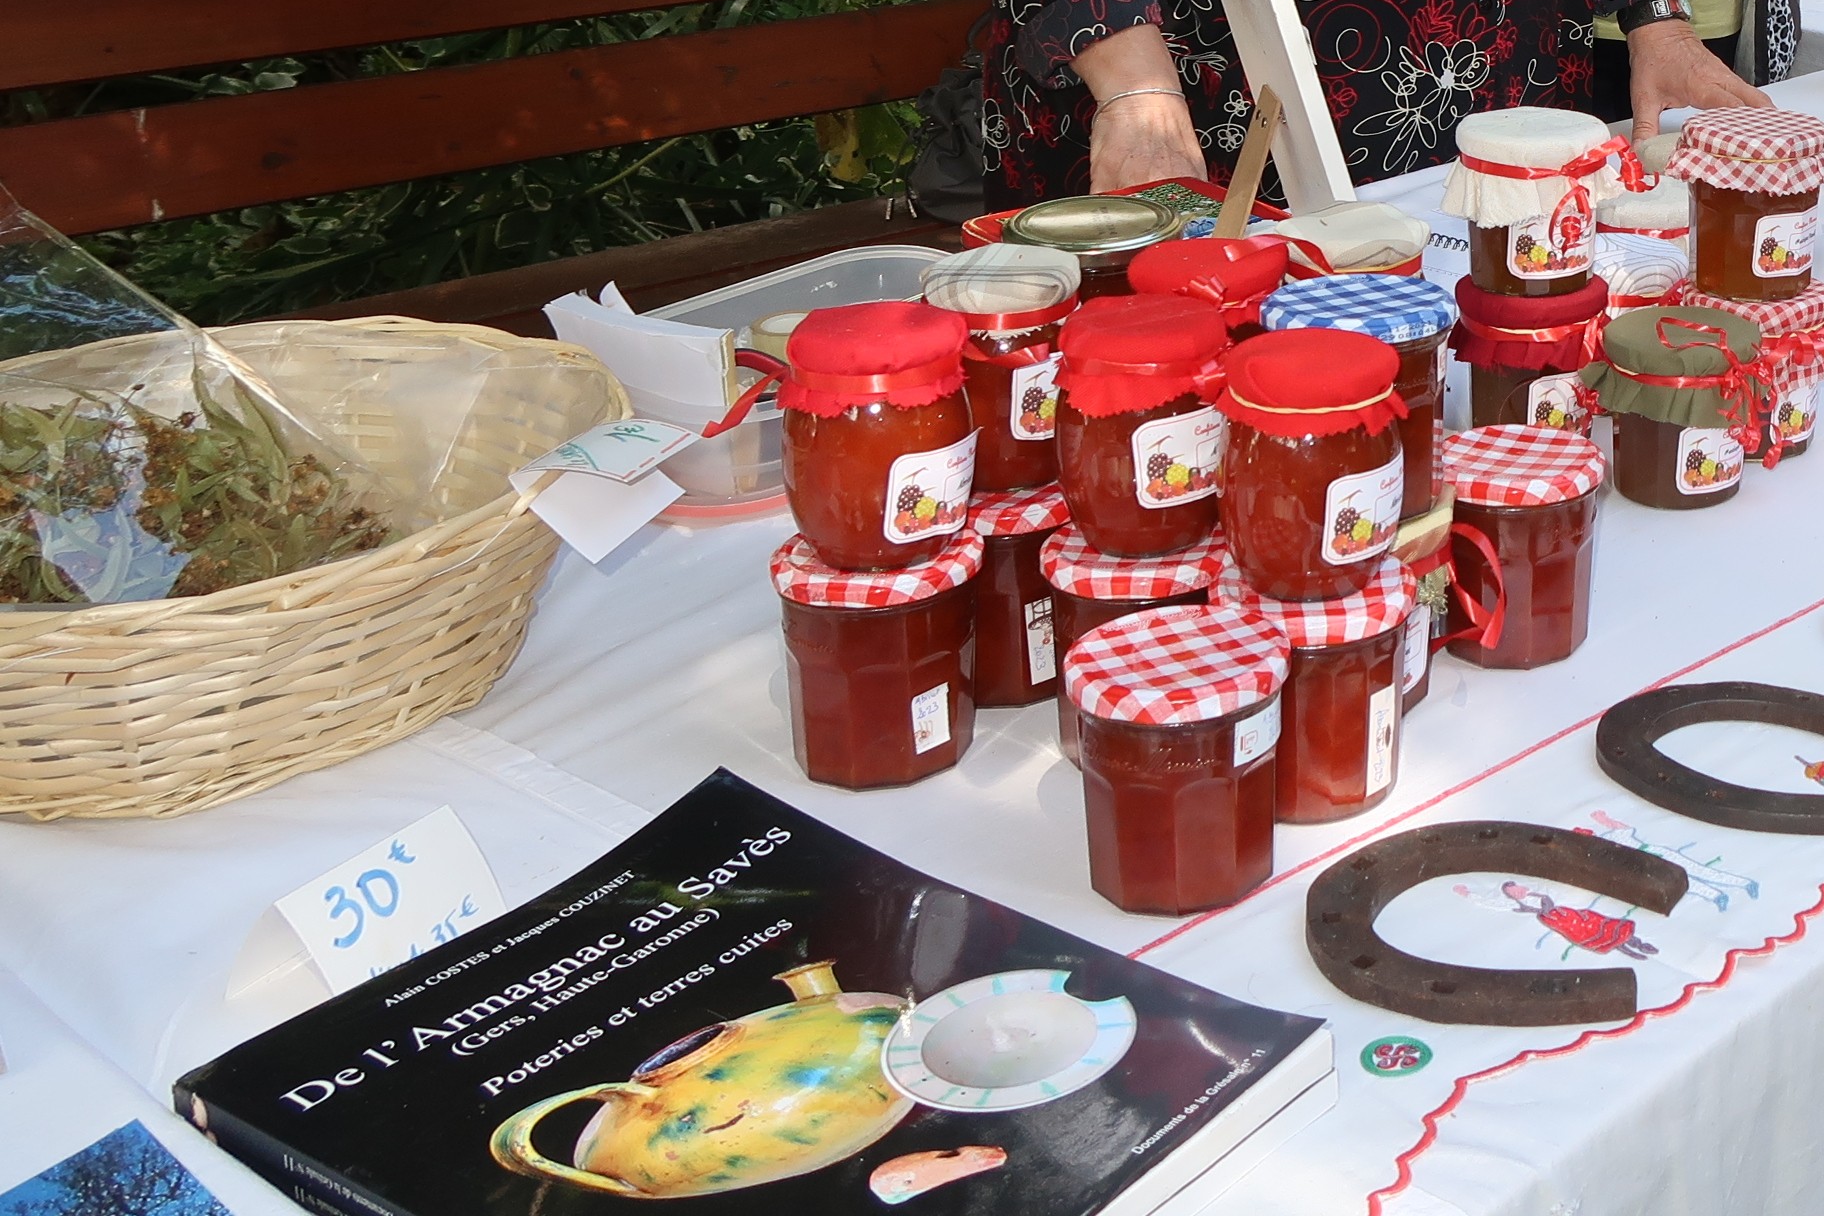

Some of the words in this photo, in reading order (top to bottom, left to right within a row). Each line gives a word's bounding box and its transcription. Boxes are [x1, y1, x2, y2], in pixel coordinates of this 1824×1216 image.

[279, 1067, 366, 1112] De
[410, 931, 626, 1052] Armagnac
[629, 901, 682, 934] au
[677, 823, 793, 901] Savès
[384, 984, 426, 1008] Alain
[425, 952, 490, 986] COSTES
[492, 943, 507, 955] et
[506, 917, 560, 947] Jacques
[558, 870, 635, 918] COUZINET
[450, 1008, 536, 1057] (Gers,
[534, 907, 720, 1014] Haute-Garonne)
[480, 1024, 605, 1097] Poteries
[609, 1003, 638, 1026] et
[638, 960, 715, 1007] terres
[719, 917, 794, 965] cuites
[1131, 1113, 1187, 1155] Documents
